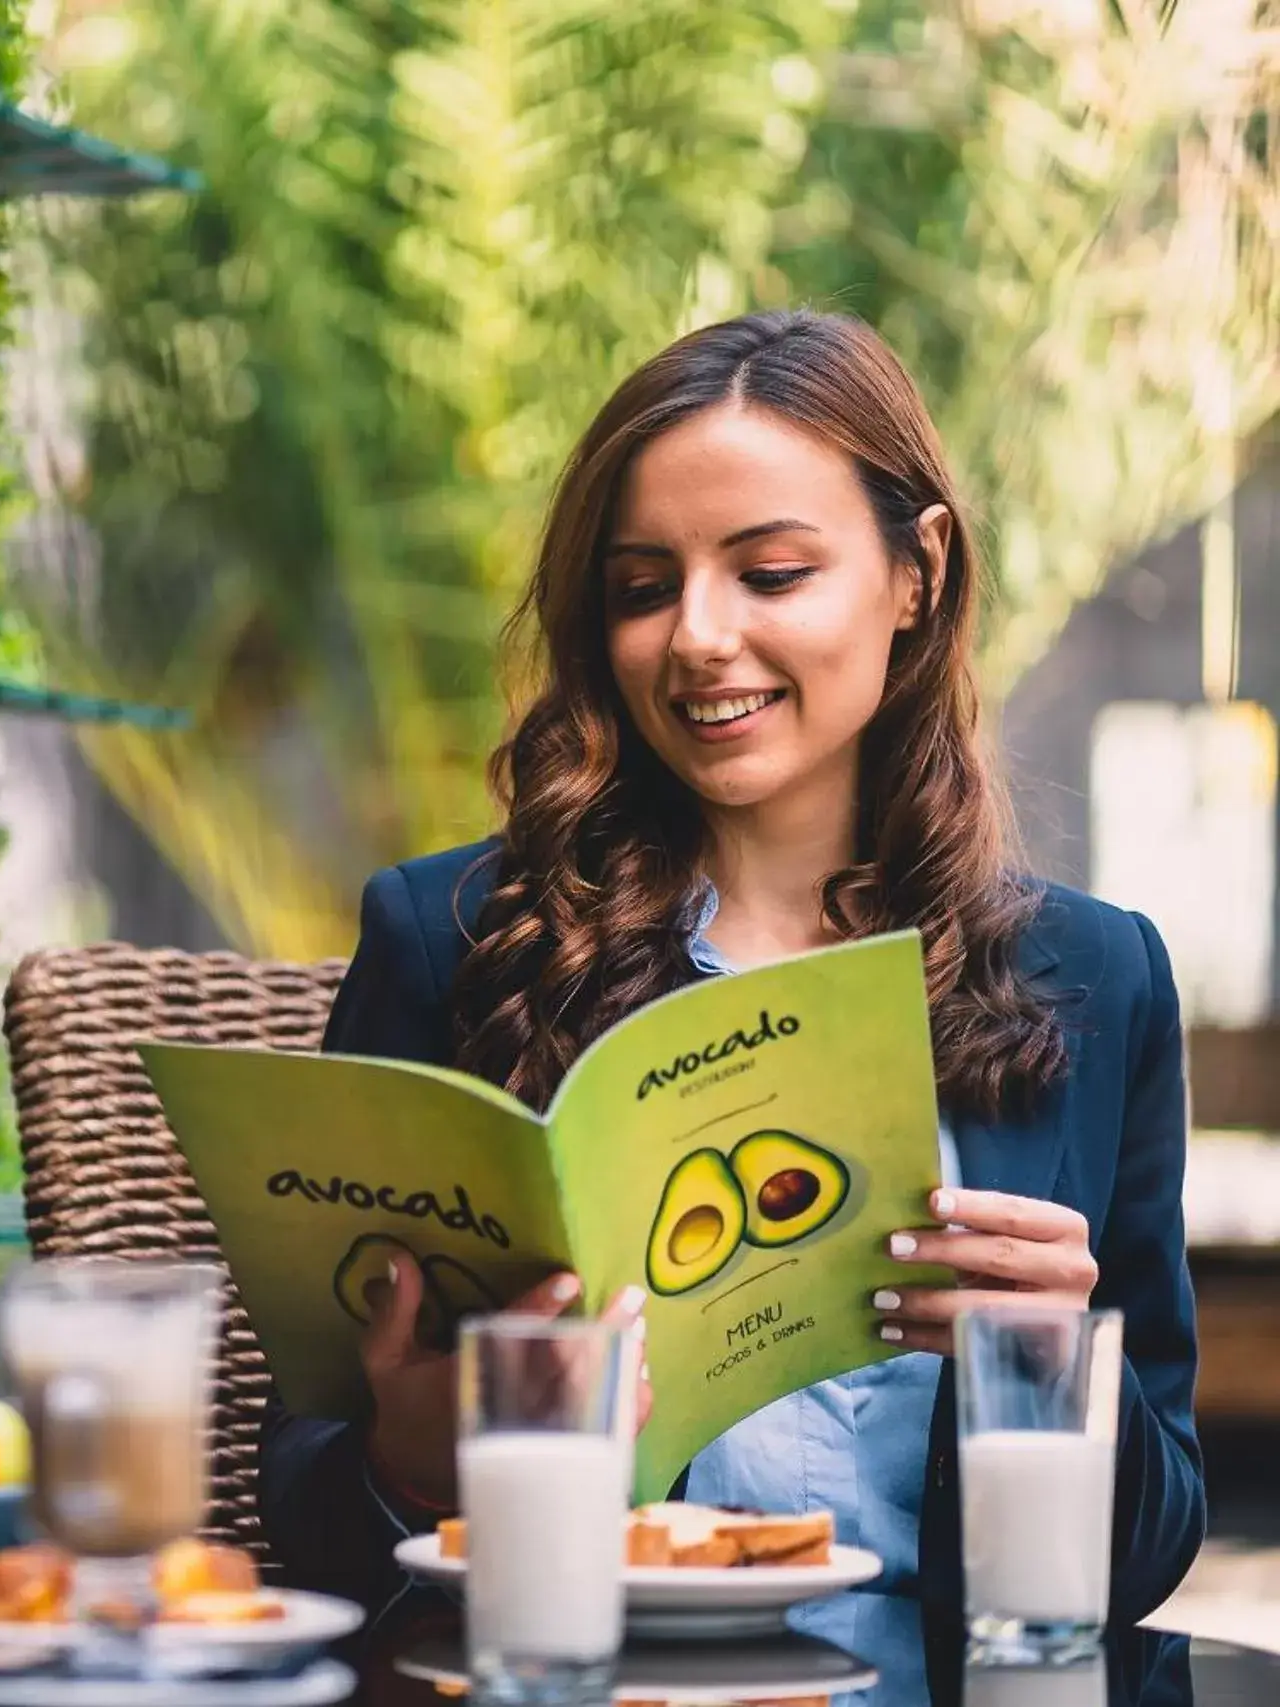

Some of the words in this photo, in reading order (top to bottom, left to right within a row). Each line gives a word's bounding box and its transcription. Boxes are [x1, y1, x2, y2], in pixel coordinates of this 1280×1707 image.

[636, 1010, 801, 1101] avocado
[267, 1169, 510, 1249] avocado
[705, 1346, 752, 1382] FOODS
[772, 1316, 816, 1343] DRINKS
[726, 1301, 783, 1346] MENU
